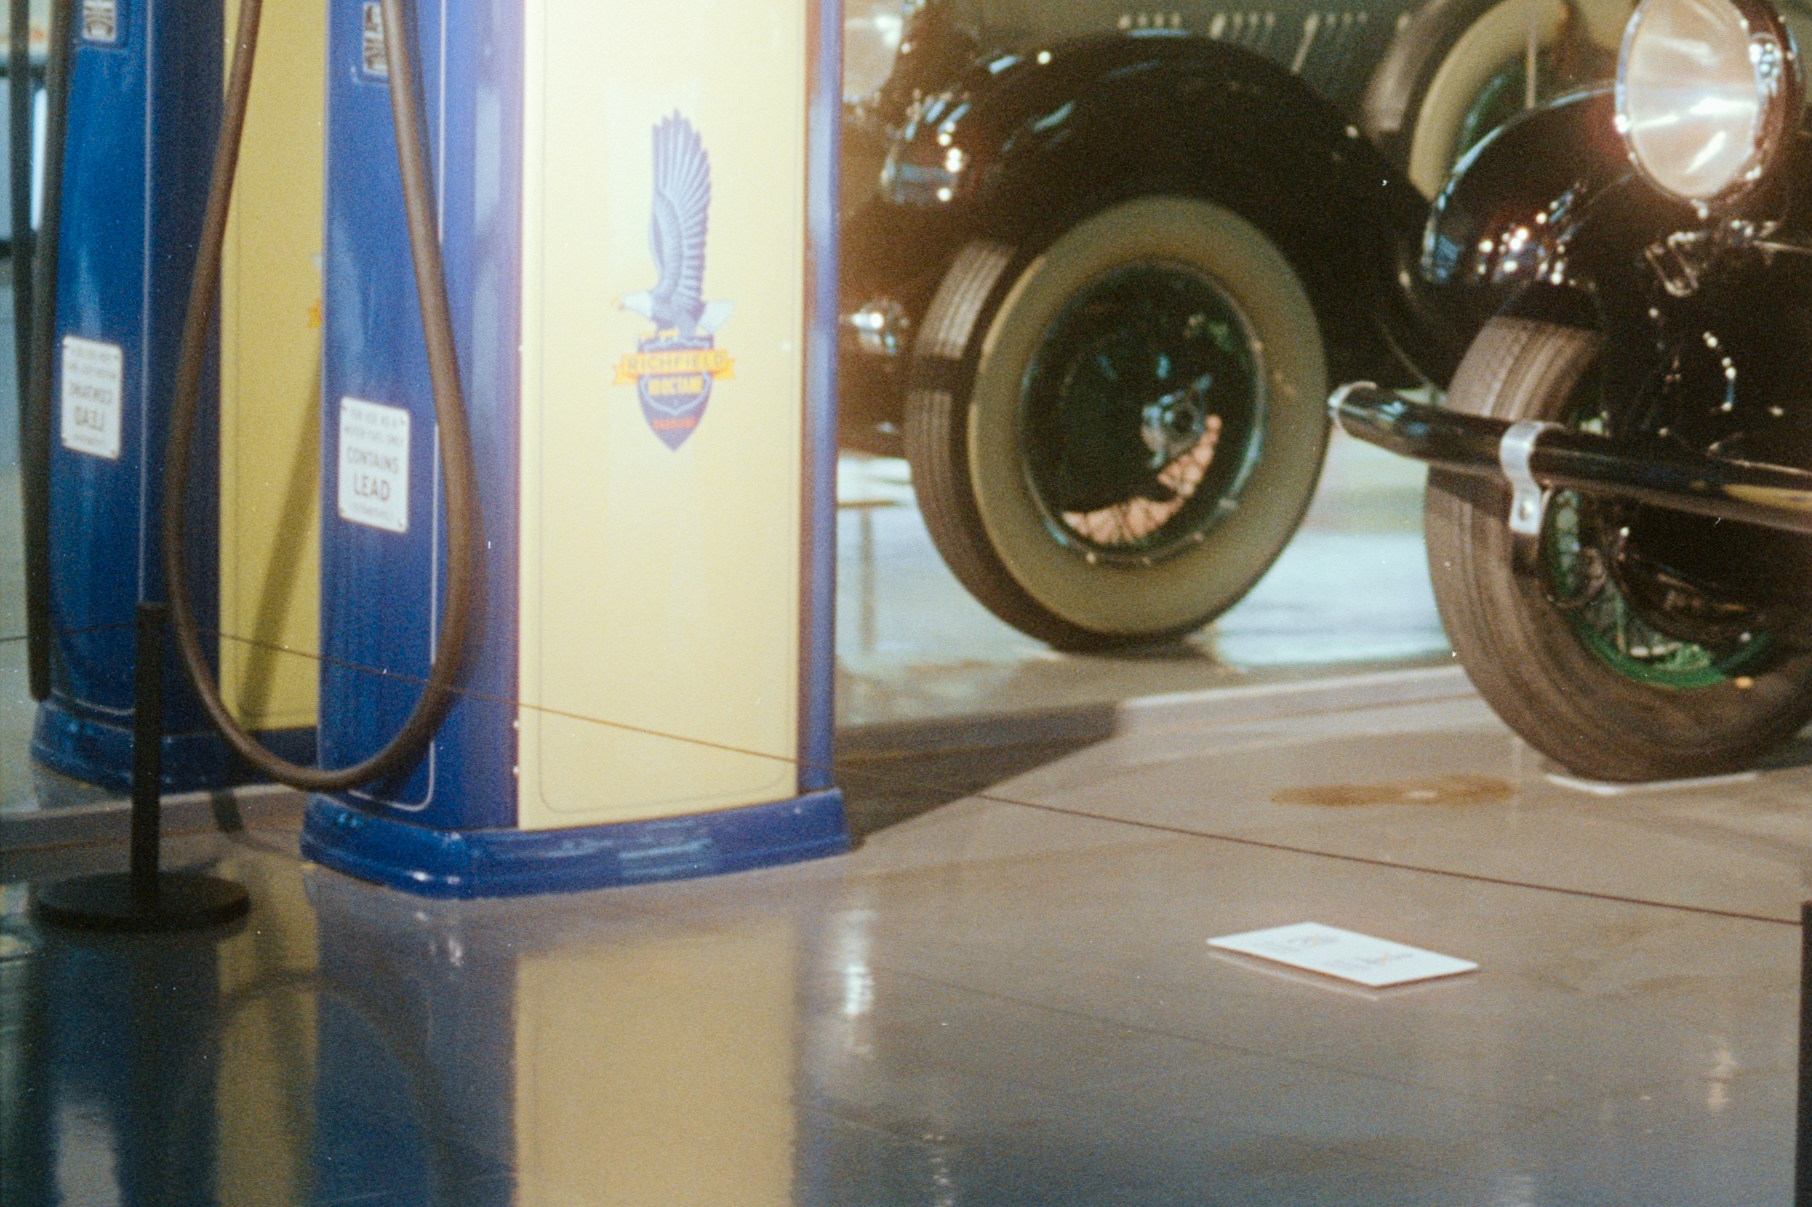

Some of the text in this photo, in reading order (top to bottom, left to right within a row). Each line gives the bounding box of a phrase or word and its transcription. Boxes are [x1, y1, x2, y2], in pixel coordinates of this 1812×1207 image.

[627, 353, 725, 371] RICHFIELD
[347, 447, 399, 475] CONTAINS
[353, 472, 391, 502] LEAD
